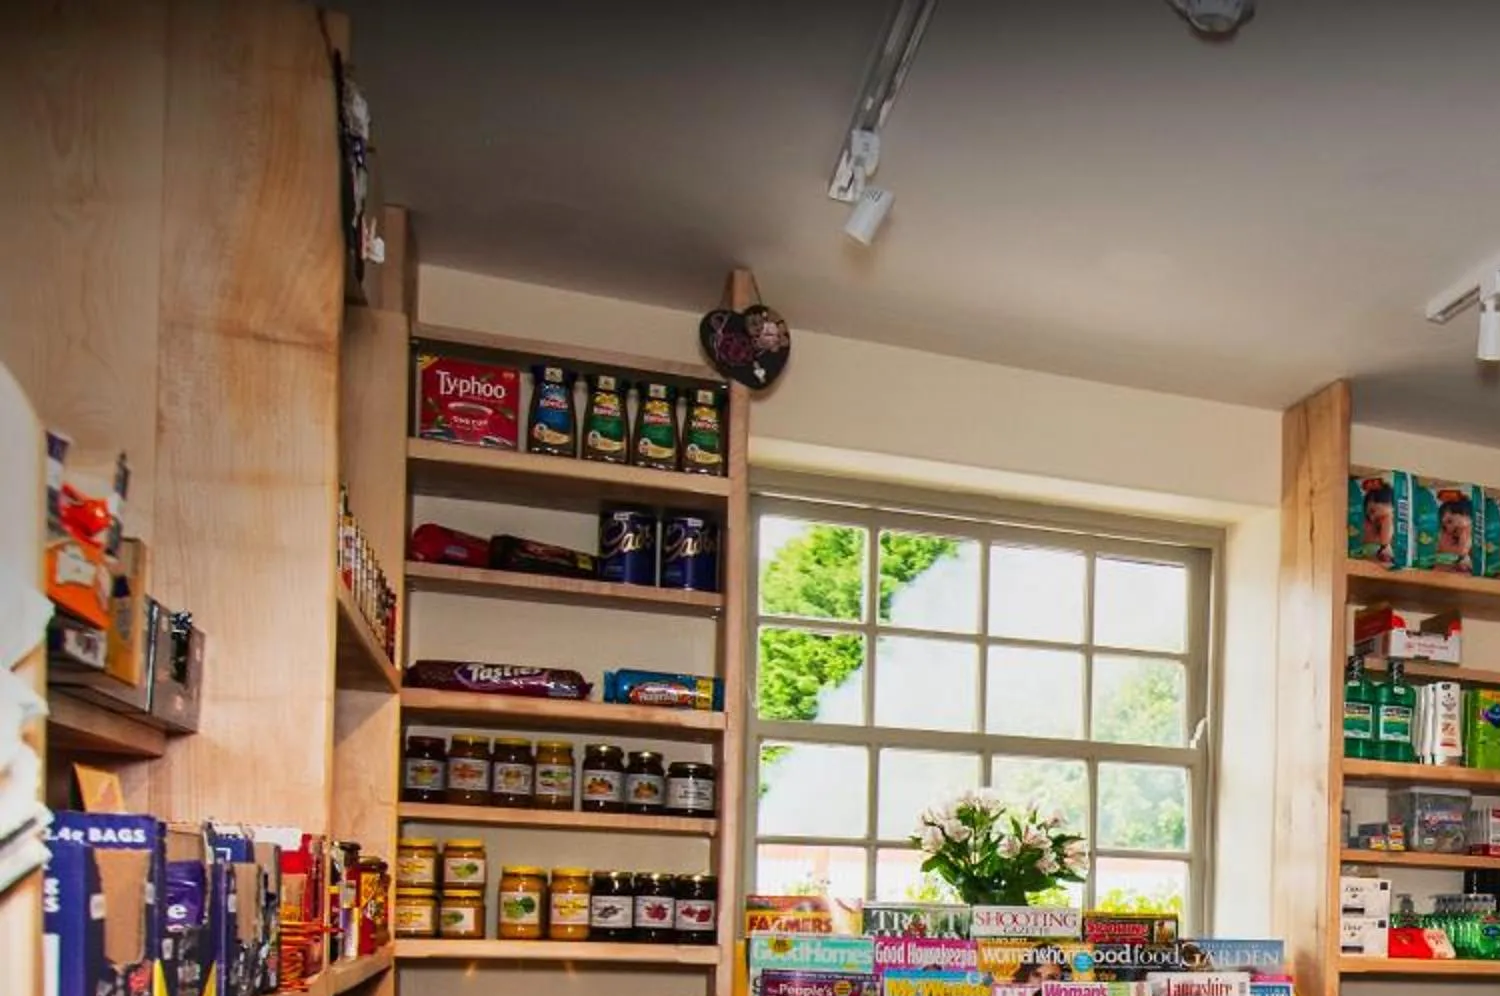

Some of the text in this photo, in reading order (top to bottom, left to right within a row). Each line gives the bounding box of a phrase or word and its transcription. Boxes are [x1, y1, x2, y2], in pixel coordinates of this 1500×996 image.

[435, 369, 507, 400] Typhoo
[87, 827, 147, 845] BAGS
[975, 911, 1077, 928] SHOOTING
[875, 941, 906, 964] Good
[1092, 942, 1181, 966] ood food
[1179, 942, 1279, 968] GARDEN
